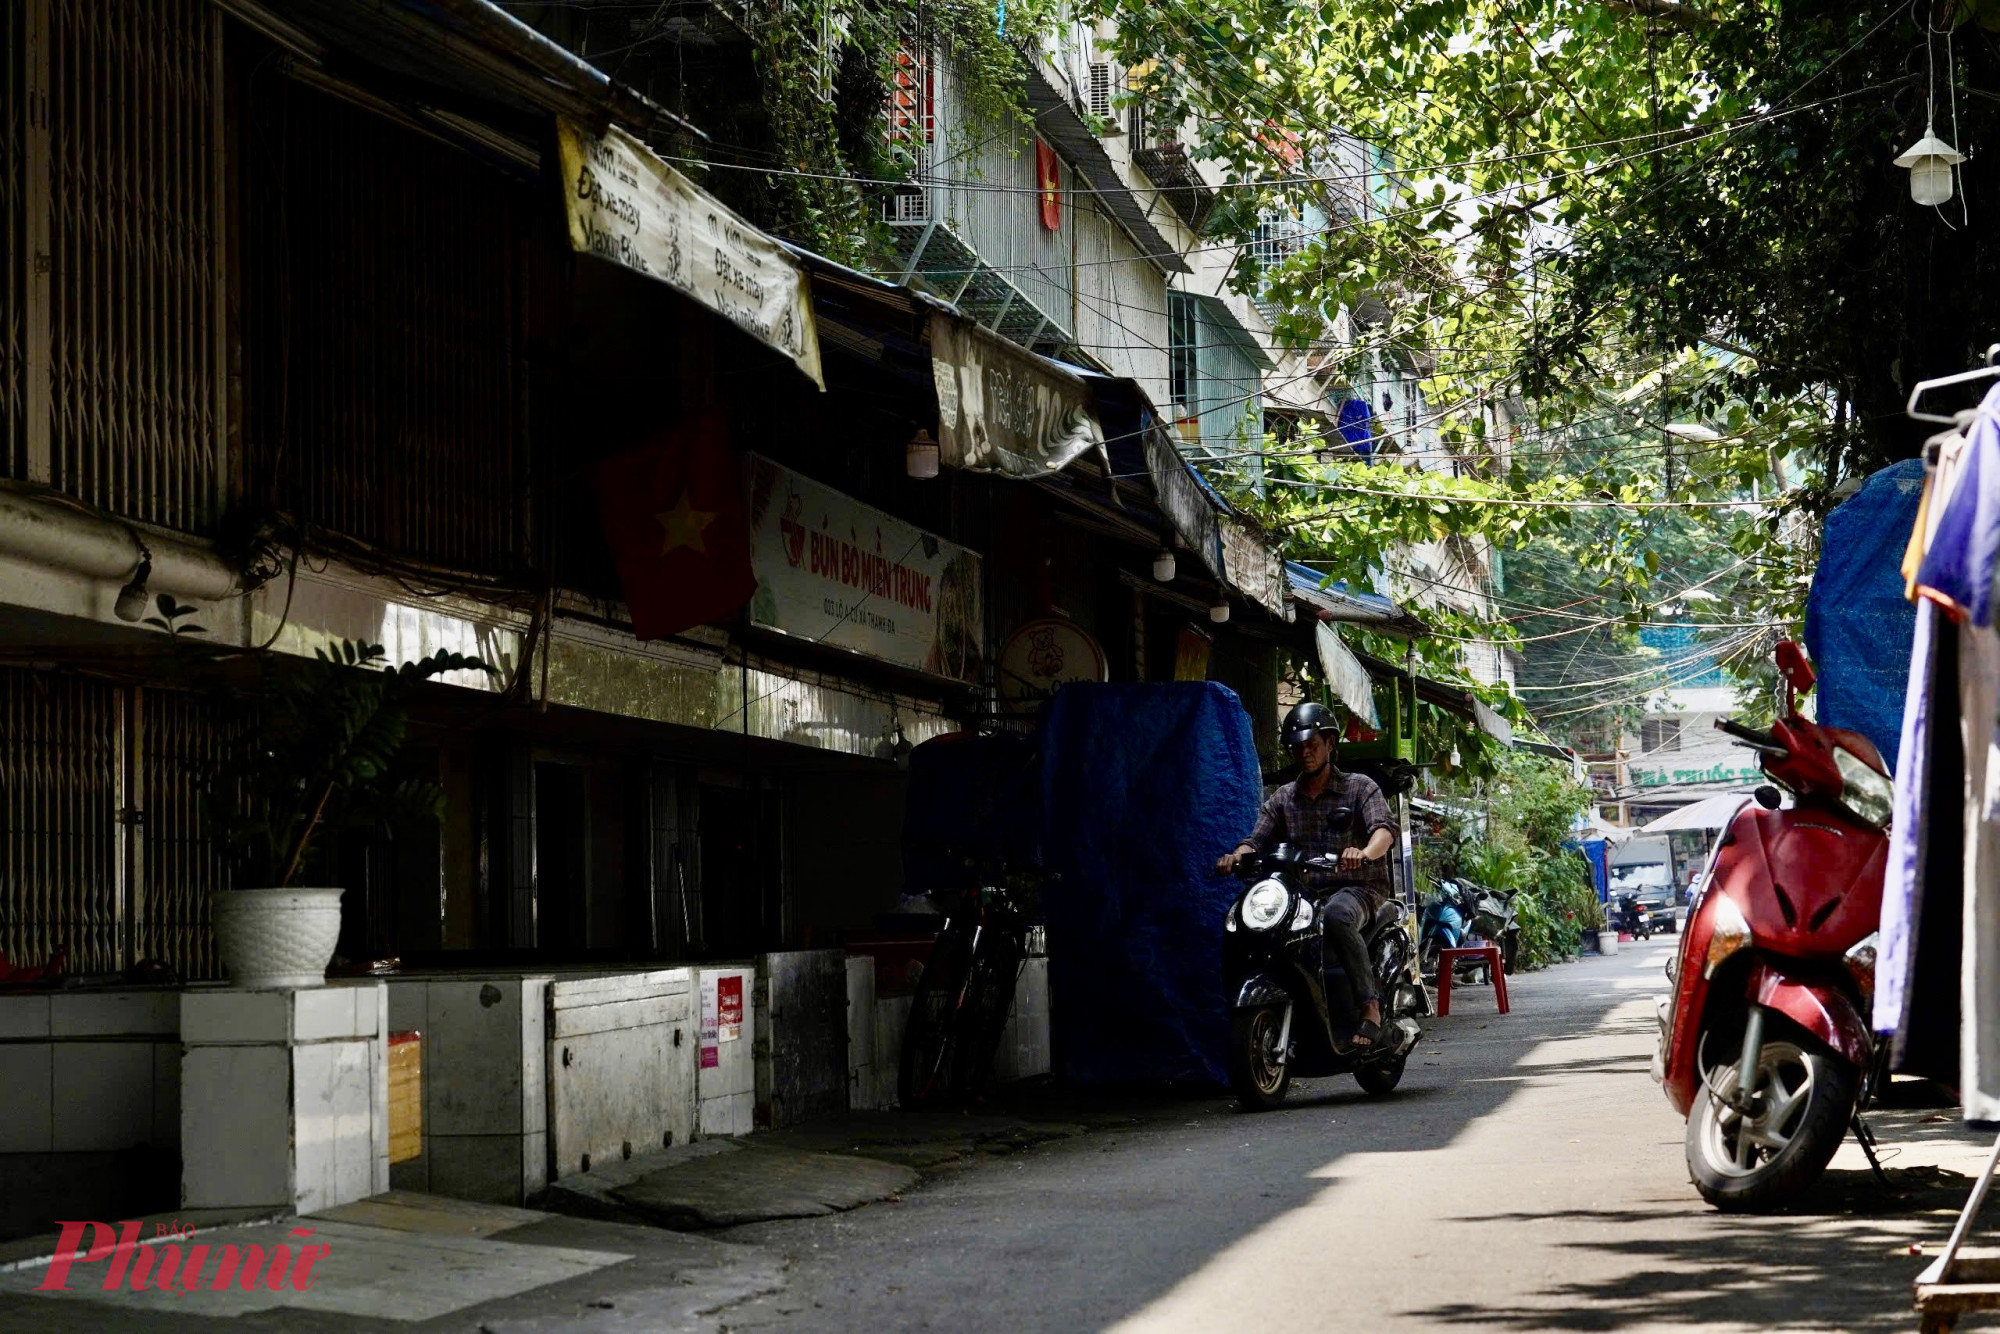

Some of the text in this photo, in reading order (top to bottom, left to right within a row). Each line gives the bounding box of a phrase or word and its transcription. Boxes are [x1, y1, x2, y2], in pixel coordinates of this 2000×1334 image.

[618, 195, 641, 235] máy
[715, 248, 764, 308] Đặt xe máy
[810, 514, 932, 613] BÚN BÒ MIỀN TRUNG
